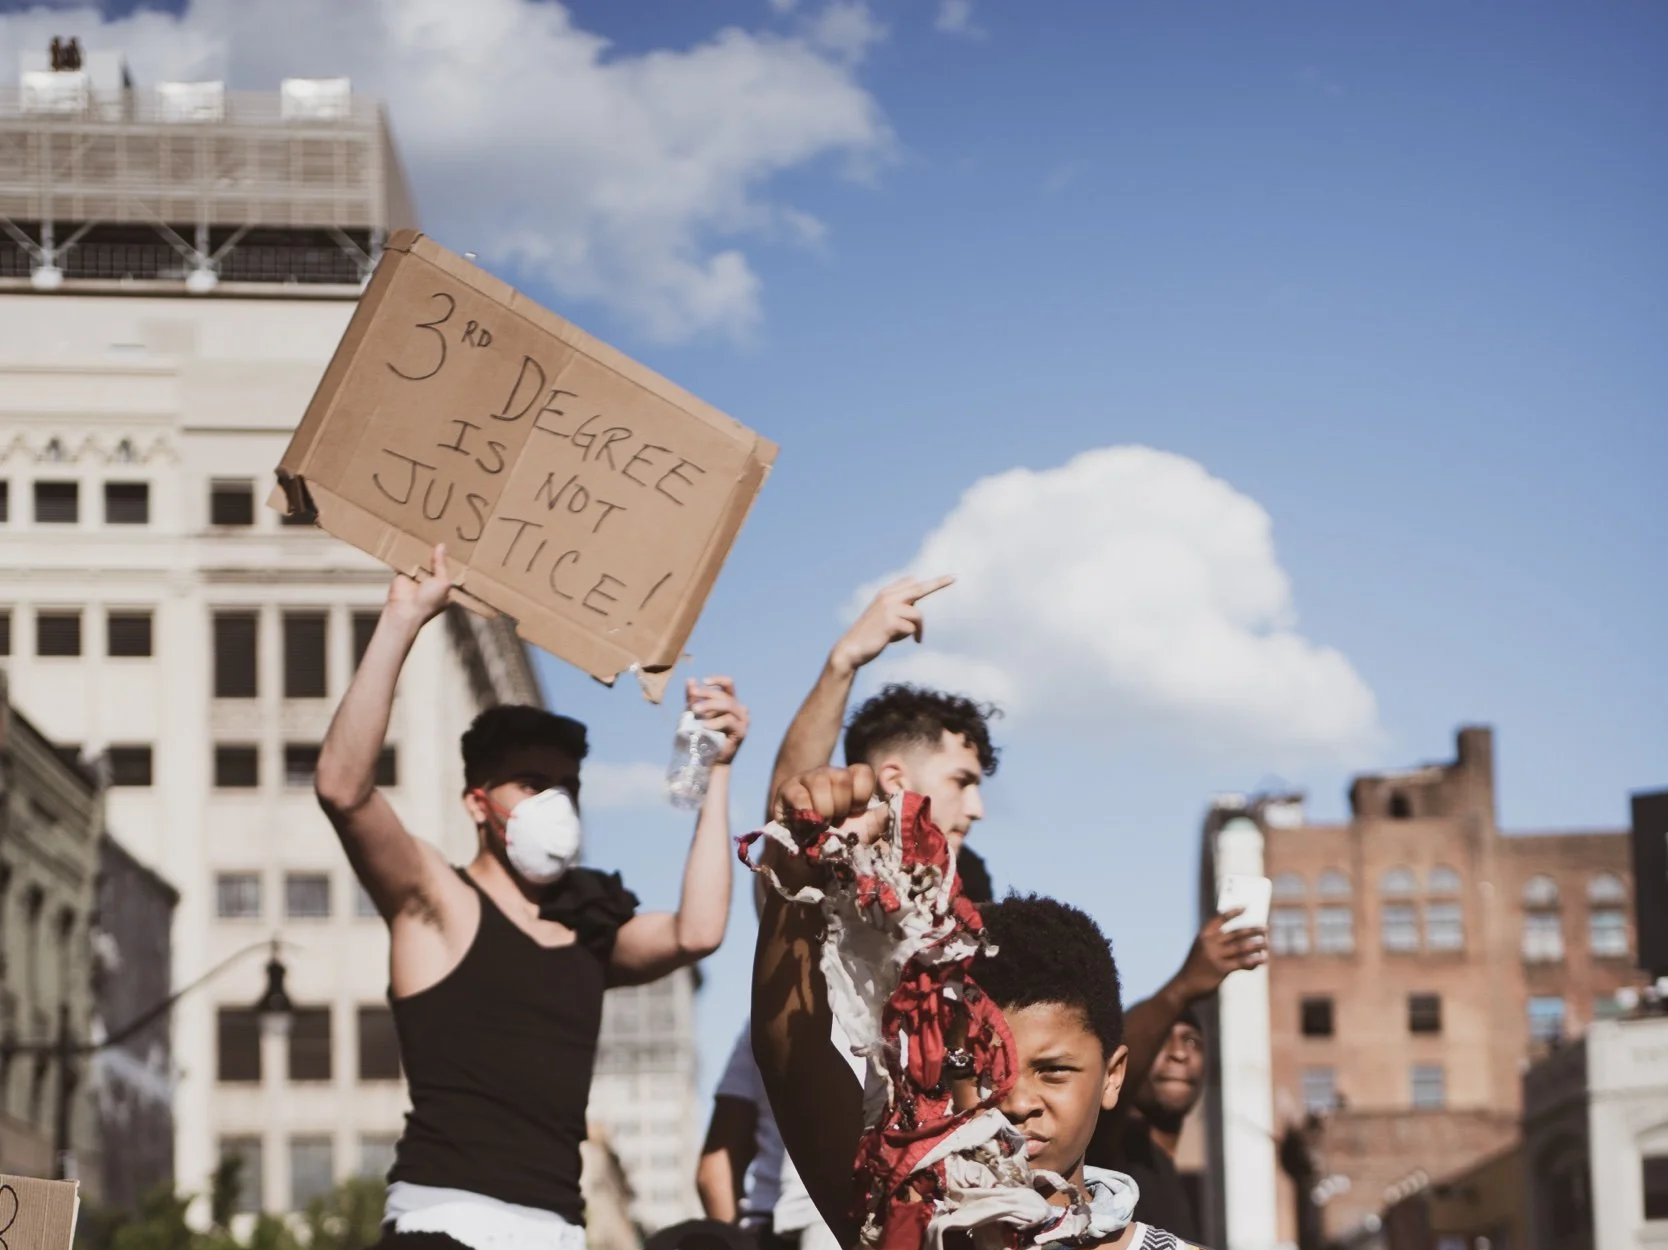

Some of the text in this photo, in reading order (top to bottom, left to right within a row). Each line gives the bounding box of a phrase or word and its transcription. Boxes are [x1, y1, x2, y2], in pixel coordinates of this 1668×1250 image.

[437, 419, 627, 534] IS NOT
[490, 355, 706, 506] DEGREE
[372, 447, 673, 626] JUSTICE!
